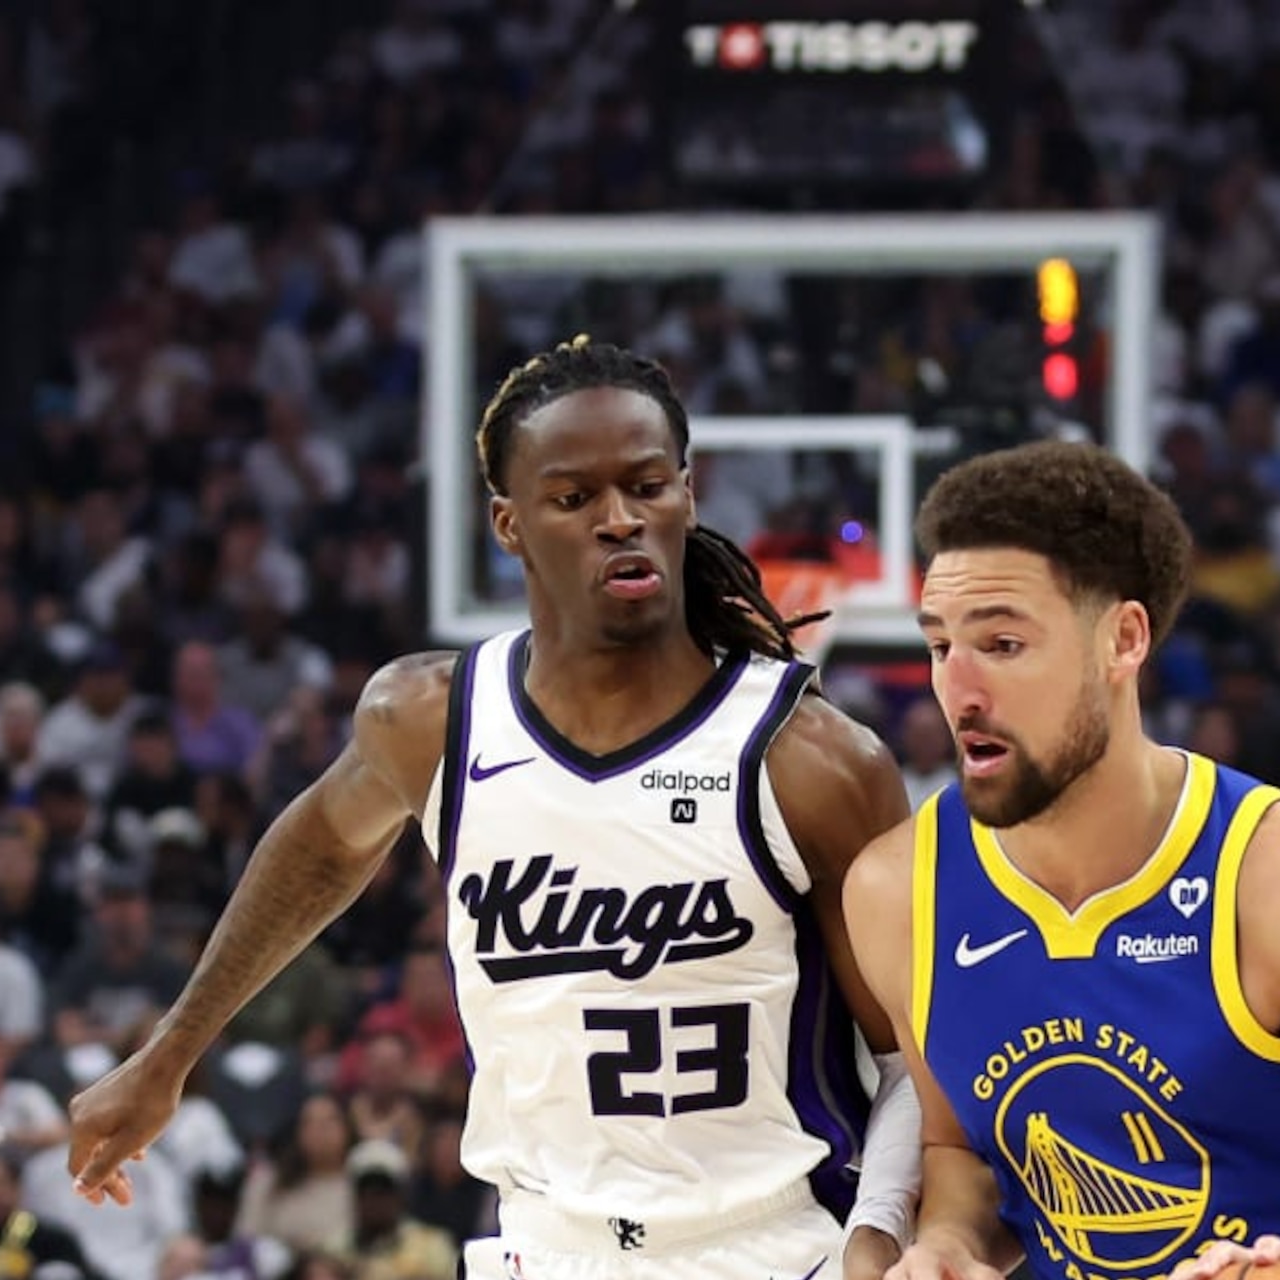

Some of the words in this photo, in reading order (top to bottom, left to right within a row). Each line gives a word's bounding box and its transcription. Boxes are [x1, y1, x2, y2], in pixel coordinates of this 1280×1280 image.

[767, 22, 977, 71] TISSOT
[641, 770, 731, 795] dialpad
[459, 853, 754, 984] Kings
[1116, 933, 1199, 960] Rakuten
[583, 1003, 751, 1118] 23
[973, 1018, 1084, 1100] GOLDEN
[1096, 1024, 1183, 1102] STATE
[1121, 1111, 1166, 1164] 11
